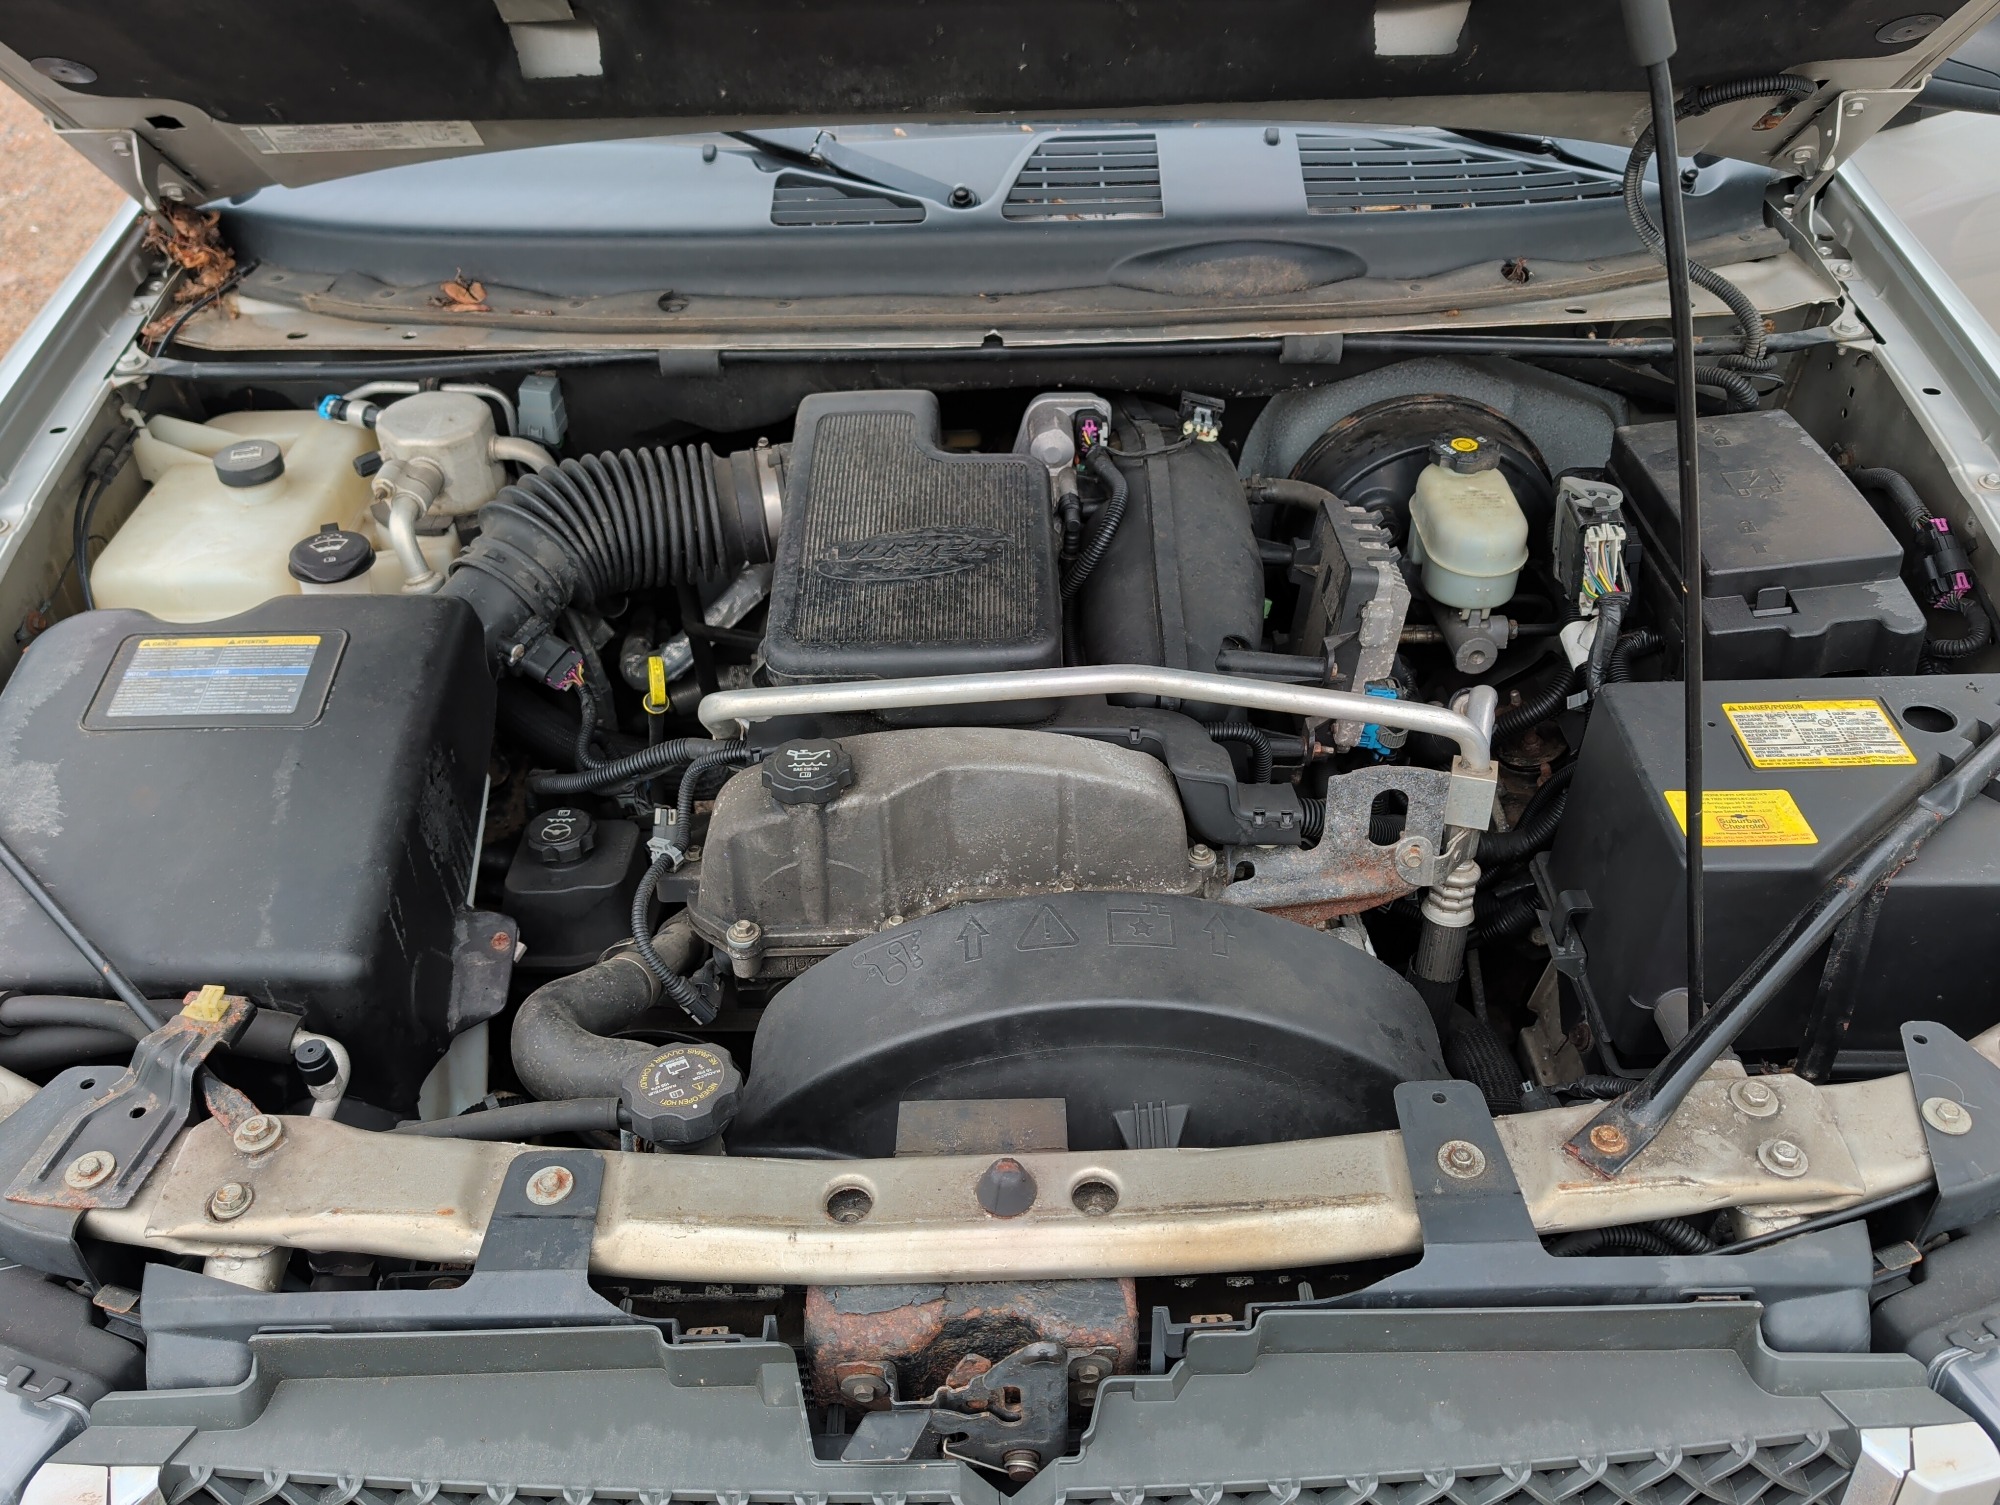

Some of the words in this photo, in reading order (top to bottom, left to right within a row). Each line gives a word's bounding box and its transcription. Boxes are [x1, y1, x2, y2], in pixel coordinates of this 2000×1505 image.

[838, 538, 1006, 561] VORTEC
[653, 1049, 684, 1064] OUVRIR
[692, 1069, 721, 1081] RADIATOR
[697, 1082, 719, 1099] NEVER
[659, 1098, 678, 1106] HOT!
[678, 1095, 699, 1105] OPEN
